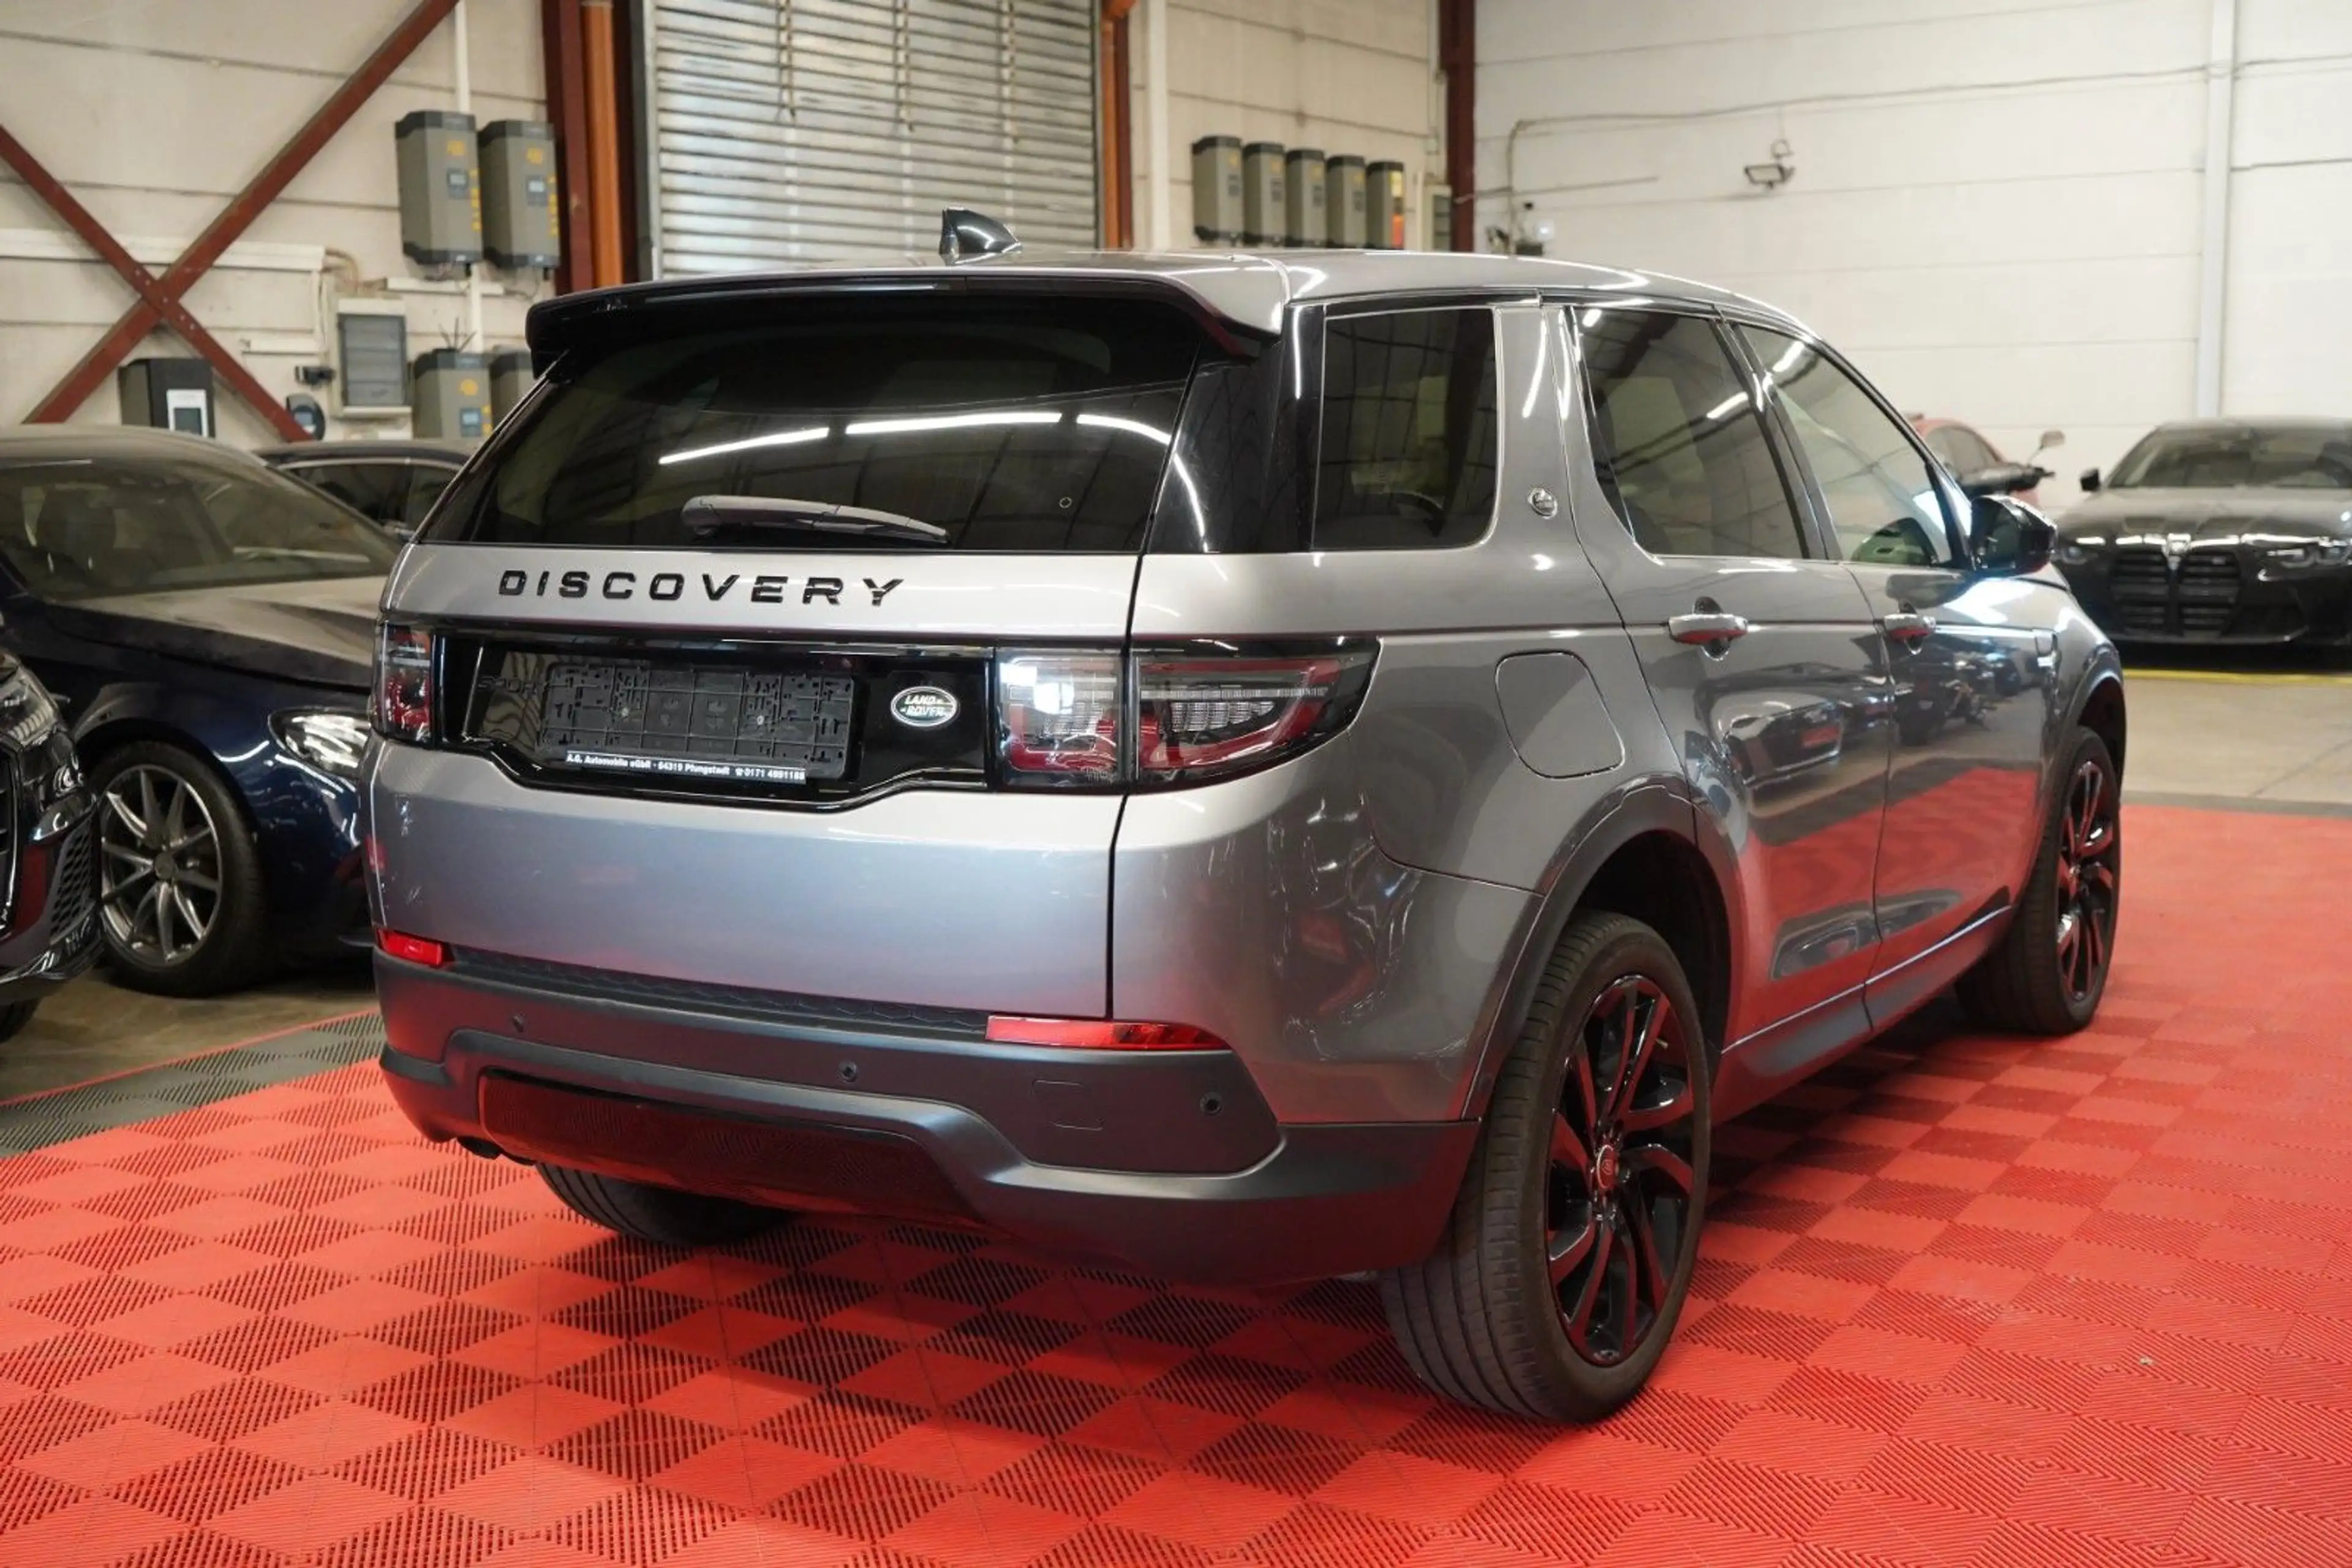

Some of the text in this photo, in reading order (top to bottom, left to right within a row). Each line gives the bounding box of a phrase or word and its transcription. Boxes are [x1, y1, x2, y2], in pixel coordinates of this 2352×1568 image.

[498, 570, 903, 606] DISCOVERY
[905, 695, 937, 704] LAND
[584, 755, 628, 766] Automobile
